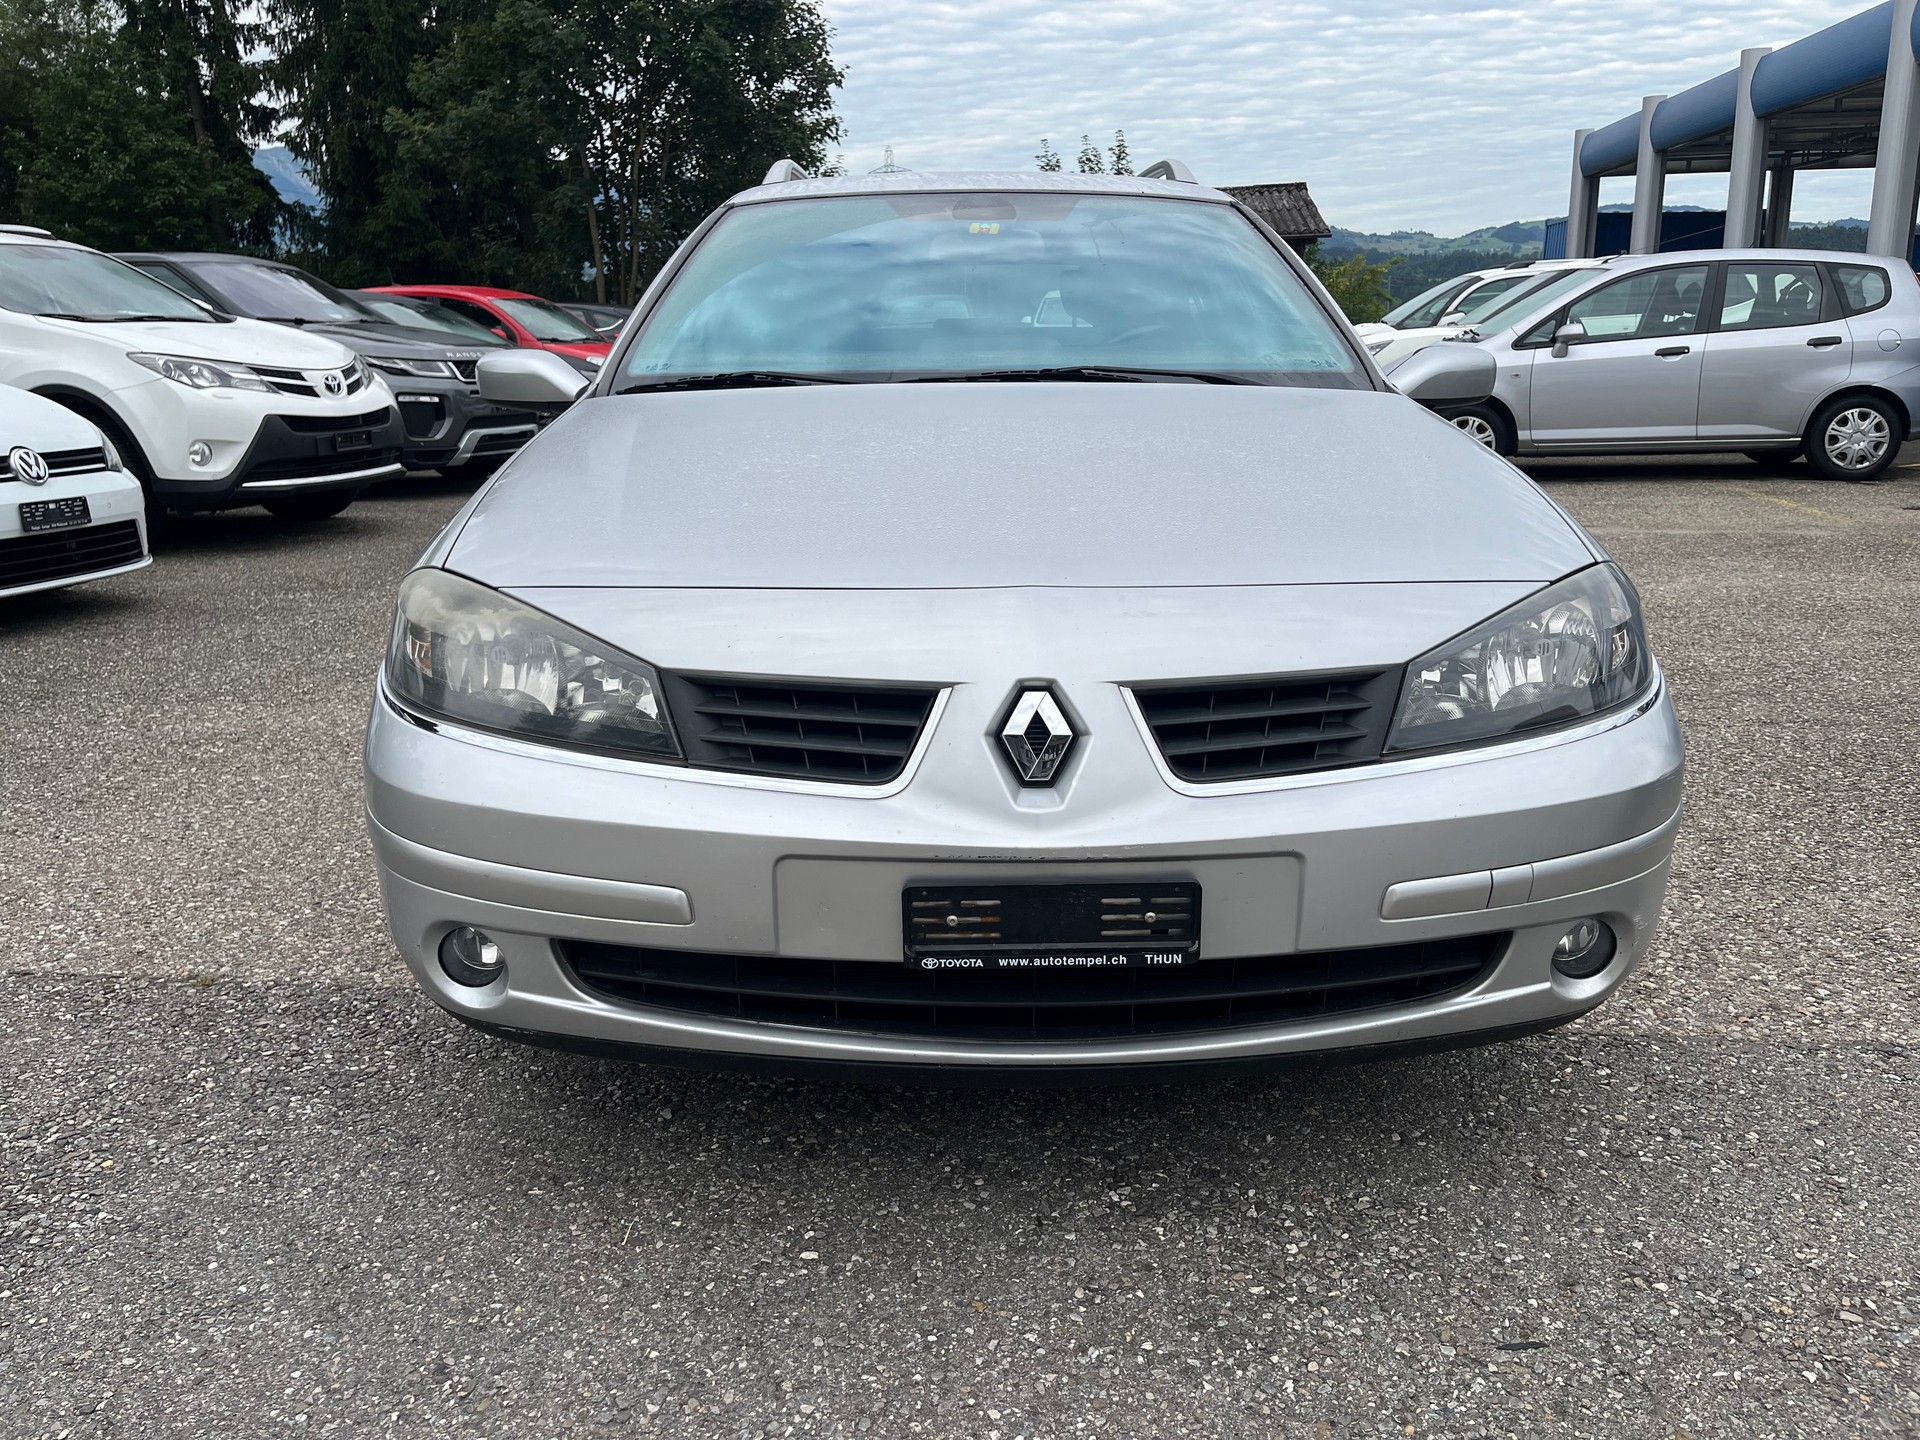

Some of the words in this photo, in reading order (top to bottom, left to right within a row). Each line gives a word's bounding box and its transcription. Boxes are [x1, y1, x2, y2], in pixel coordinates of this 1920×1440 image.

[939, 958, 984, 968] TOYOTA
[998, 954, 1127, 967] www.autotempel.ch
[1145, 954, 1182, 964] THUN
